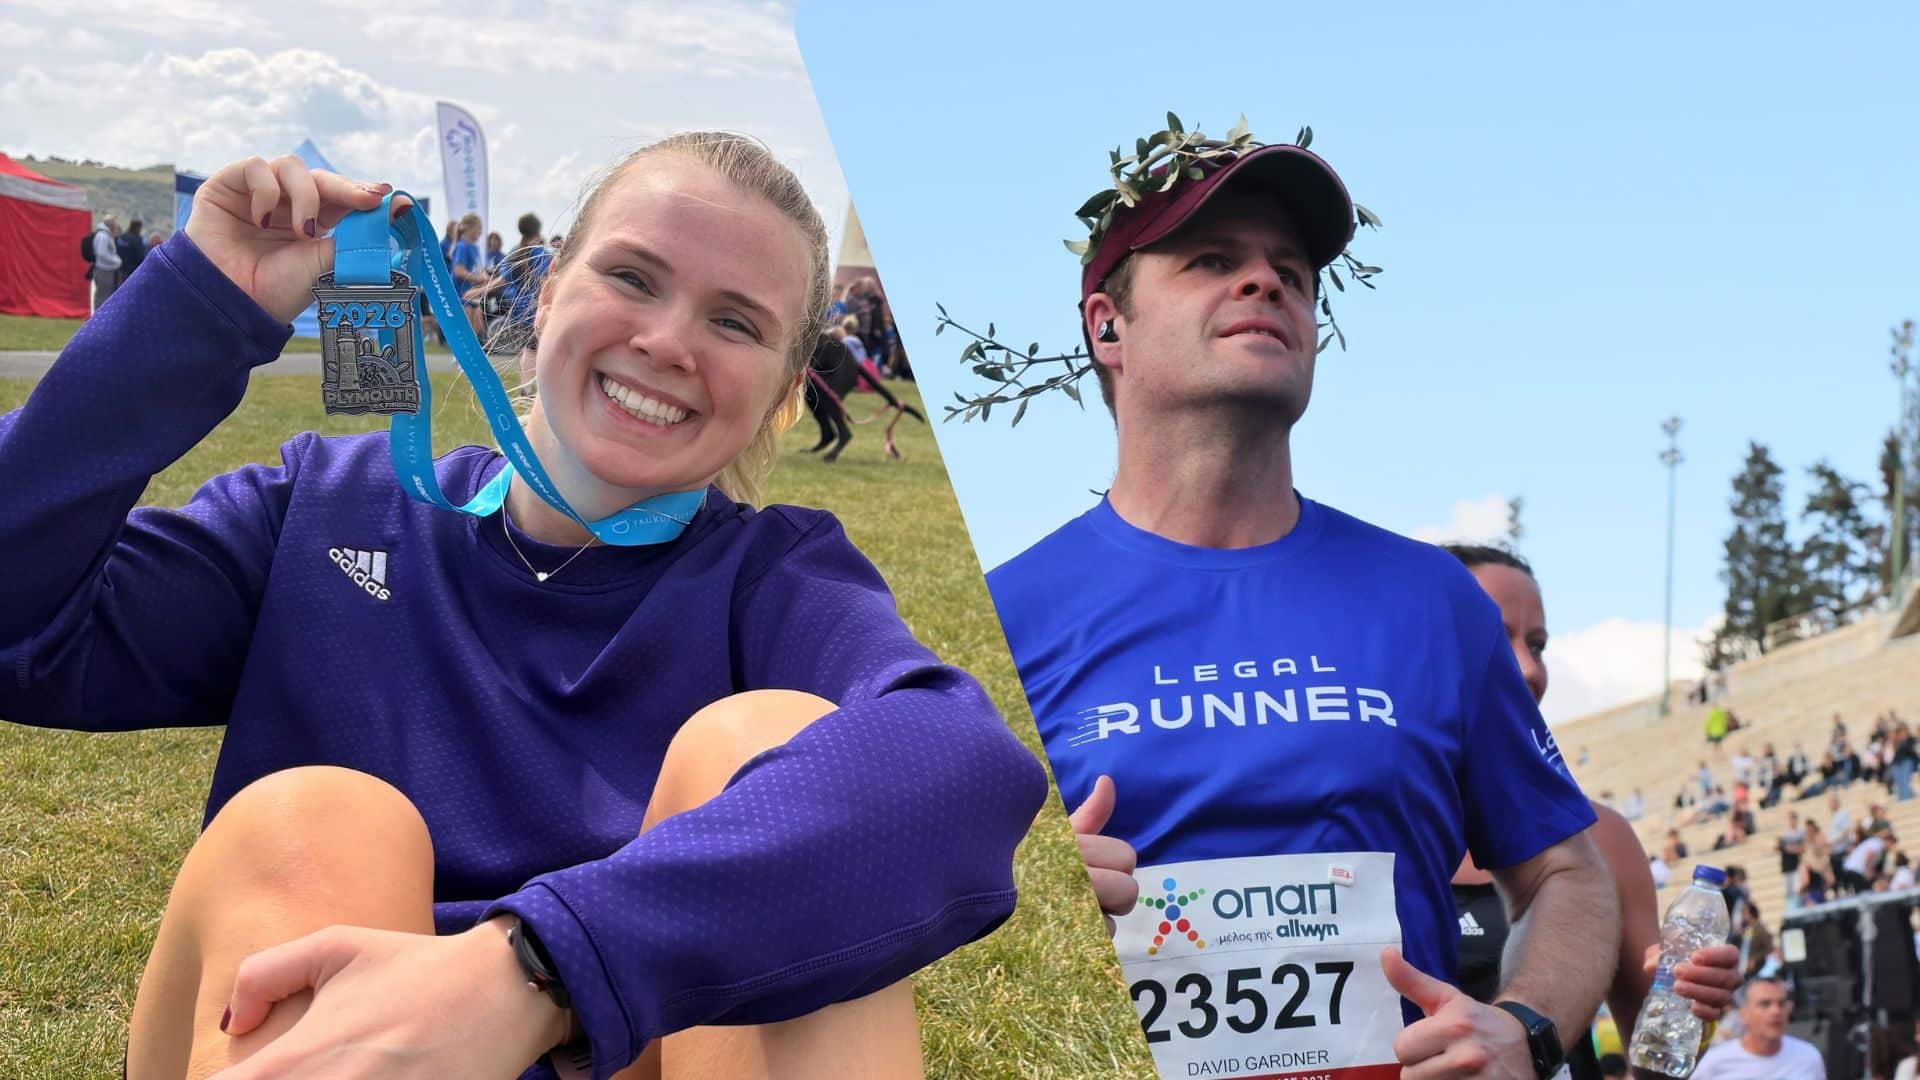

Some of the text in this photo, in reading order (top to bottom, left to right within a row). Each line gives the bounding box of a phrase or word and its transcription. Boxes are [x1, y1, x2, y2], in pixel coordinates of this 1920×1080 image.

[325, 302, 407, 329] 2026
[326, 389, 417, 405] PLYMOUTH
[329, 548, 391, 600] adidas
[1154, 655, 1337, 685] LEGAL
[1098, 686, 1398, 739] RUNNER
[1276, 919, 1339, 941] allwyn
[1130, 961, 1354, 1043] 23527
[1187, 1050, 1329, 1076] DAVID GARDNER
